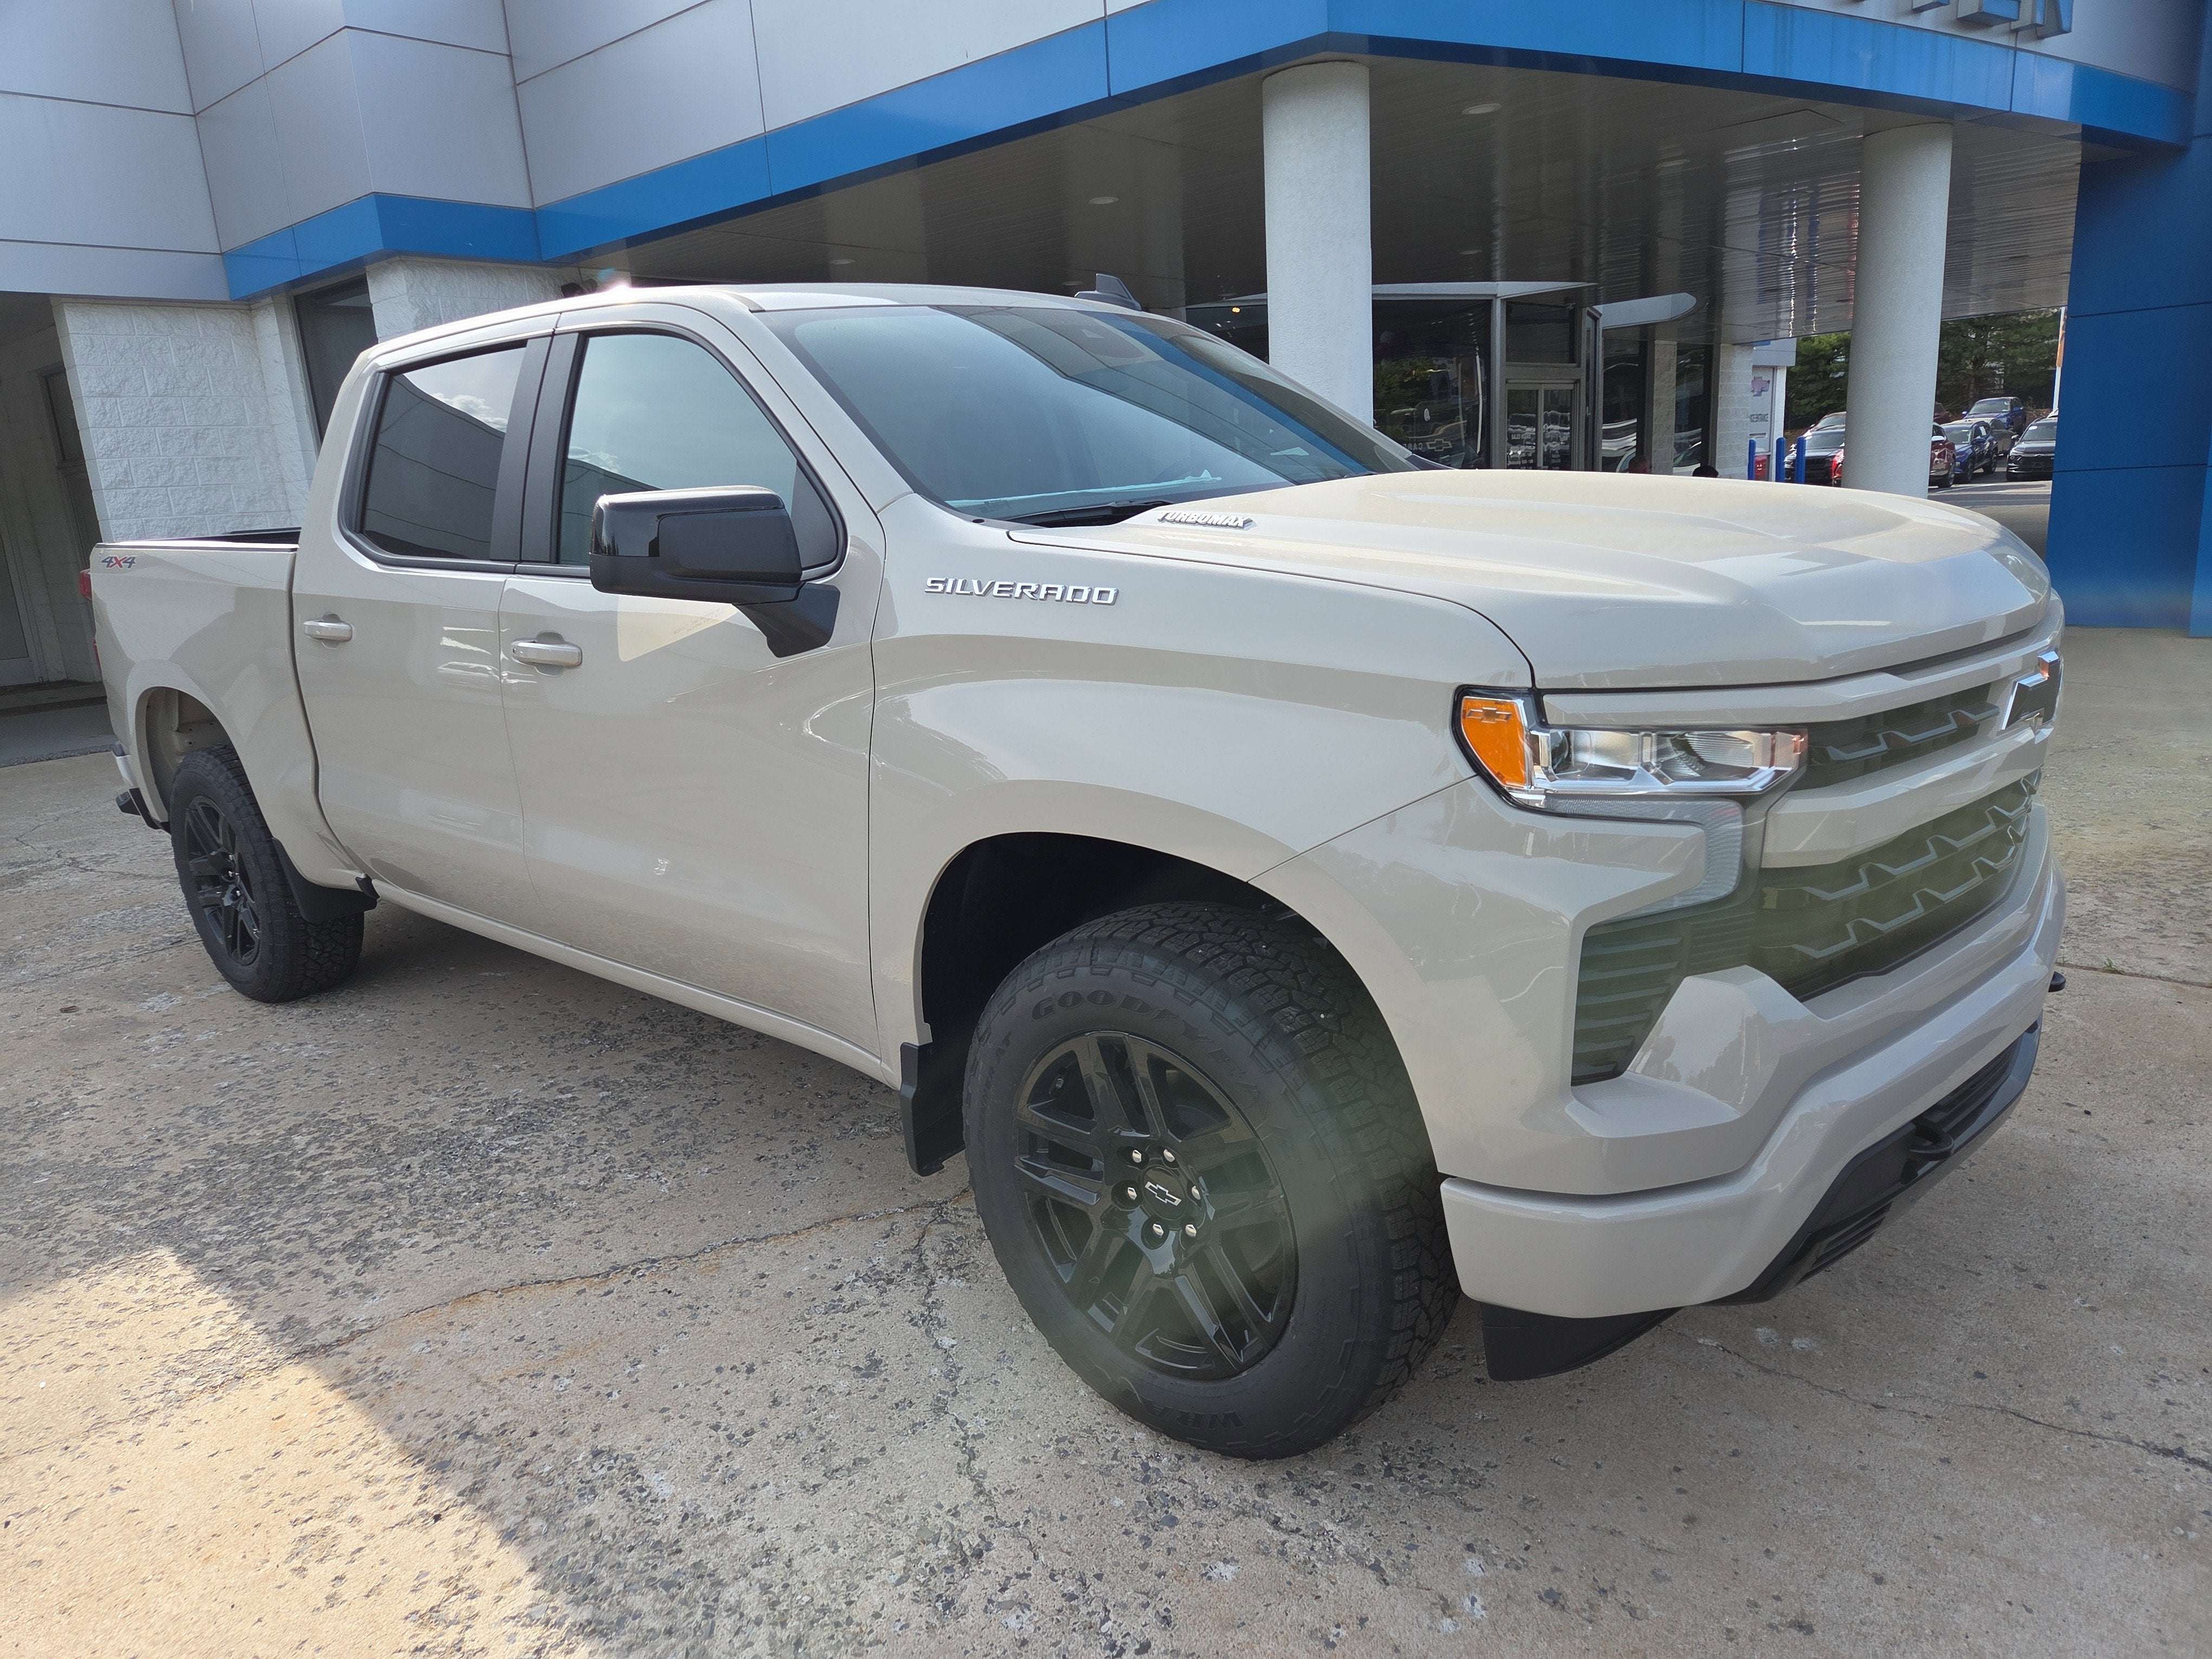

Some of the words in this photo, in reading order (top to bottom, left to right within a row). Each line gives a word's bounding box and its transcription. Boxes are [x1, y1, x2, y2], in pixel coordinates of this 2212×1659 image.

[1157, 511, 1251, 529] TURBOMAX
[101, 556, 136, 568] 4X4
[924, 577, 1119, 606] SILVERADO
